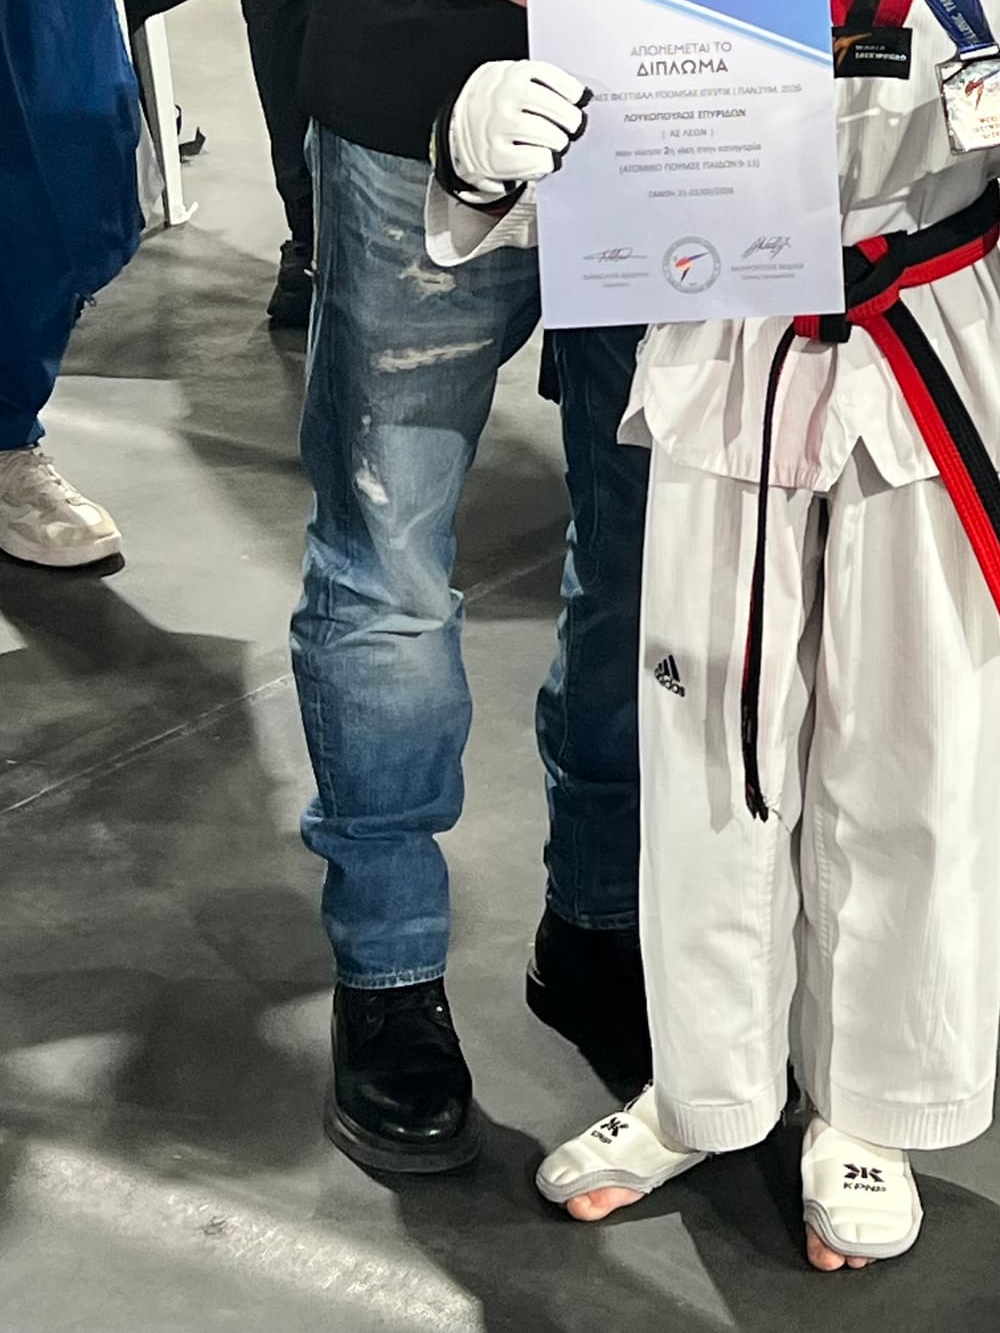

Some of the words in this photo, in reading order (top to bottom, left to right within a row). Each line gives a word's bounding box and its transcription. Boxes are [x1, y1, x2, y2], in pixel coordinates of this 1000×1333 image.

[630, 43, 710, 57] ΑΠΟΝΕΜΕΤΑΙ
[714, 41, 732, 53] ΤΟ
[637, 58, 728, 77] ΔΙΠΛΩΜΑ
